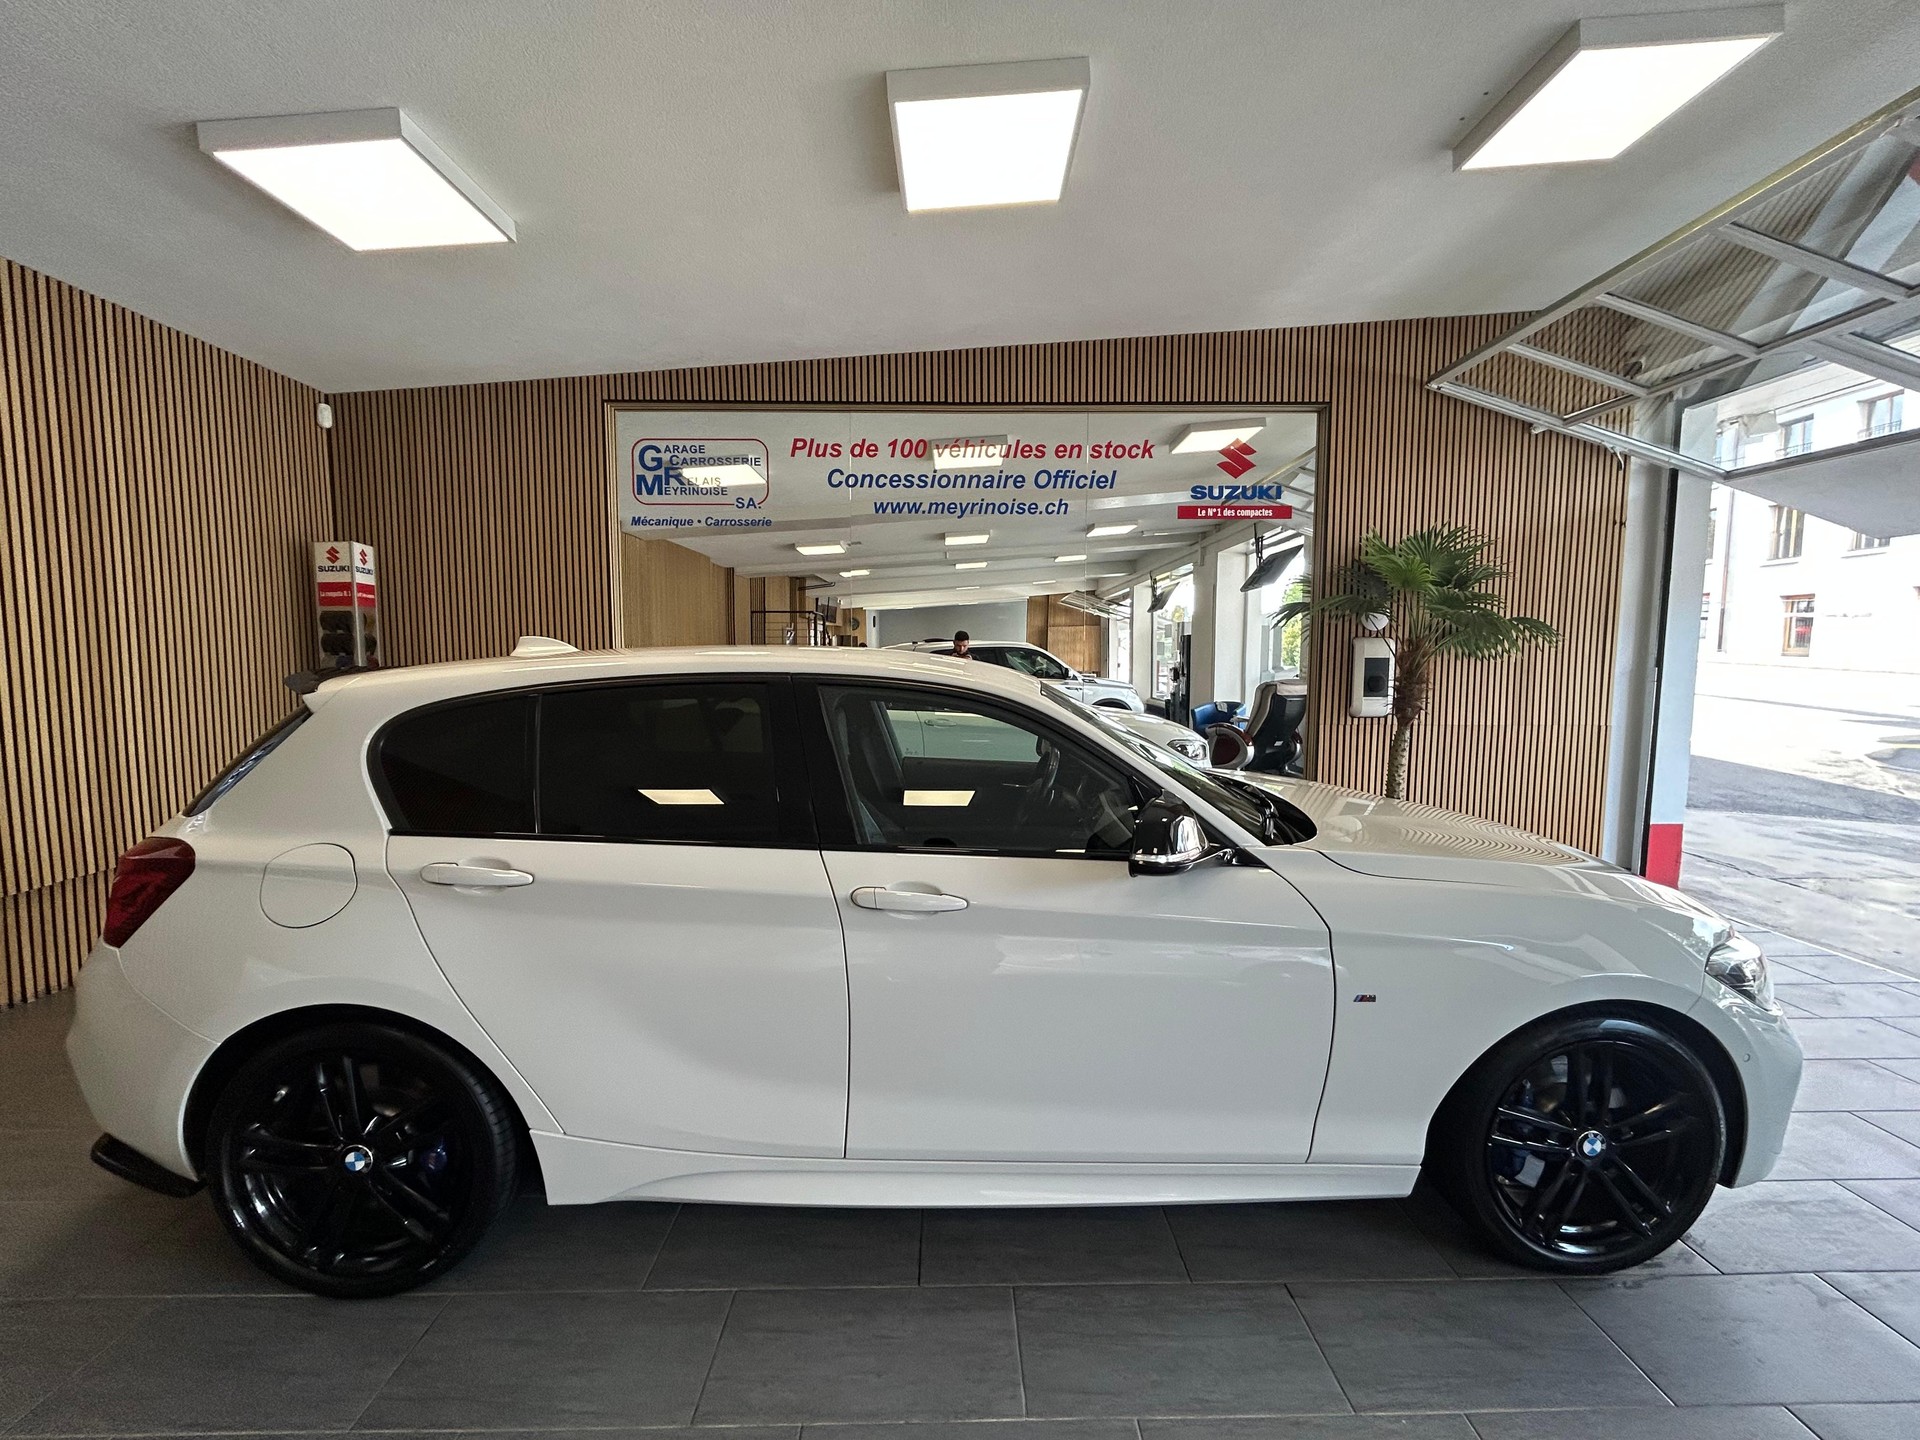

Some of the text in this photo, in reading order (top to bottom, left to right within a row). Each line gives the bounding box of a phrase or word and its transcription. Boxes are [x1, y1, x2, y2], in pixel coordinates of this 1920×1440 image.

[638, 444, 706, 472] GARAGE
[790, 438, 1156, 460] Plus de 100 véhicules en stock
[669, 455, 762, 467] CARROSSERIE
[636, 474, 728, 496] MEYRINOISE
[827, 468, 1117, 490] Concessionnaire Officiel
[1190, 485, 1282, 500] SUZUKI
[873, 498, 1069, 519] www.meyrinoise.ch
[1197, 508, 1206, 517] Le
[1223, 508, 1235, 517] des
[1236, 508, 1273, 518] compactes
[631, 516, 772, 528] Mécanique Carrosserie
